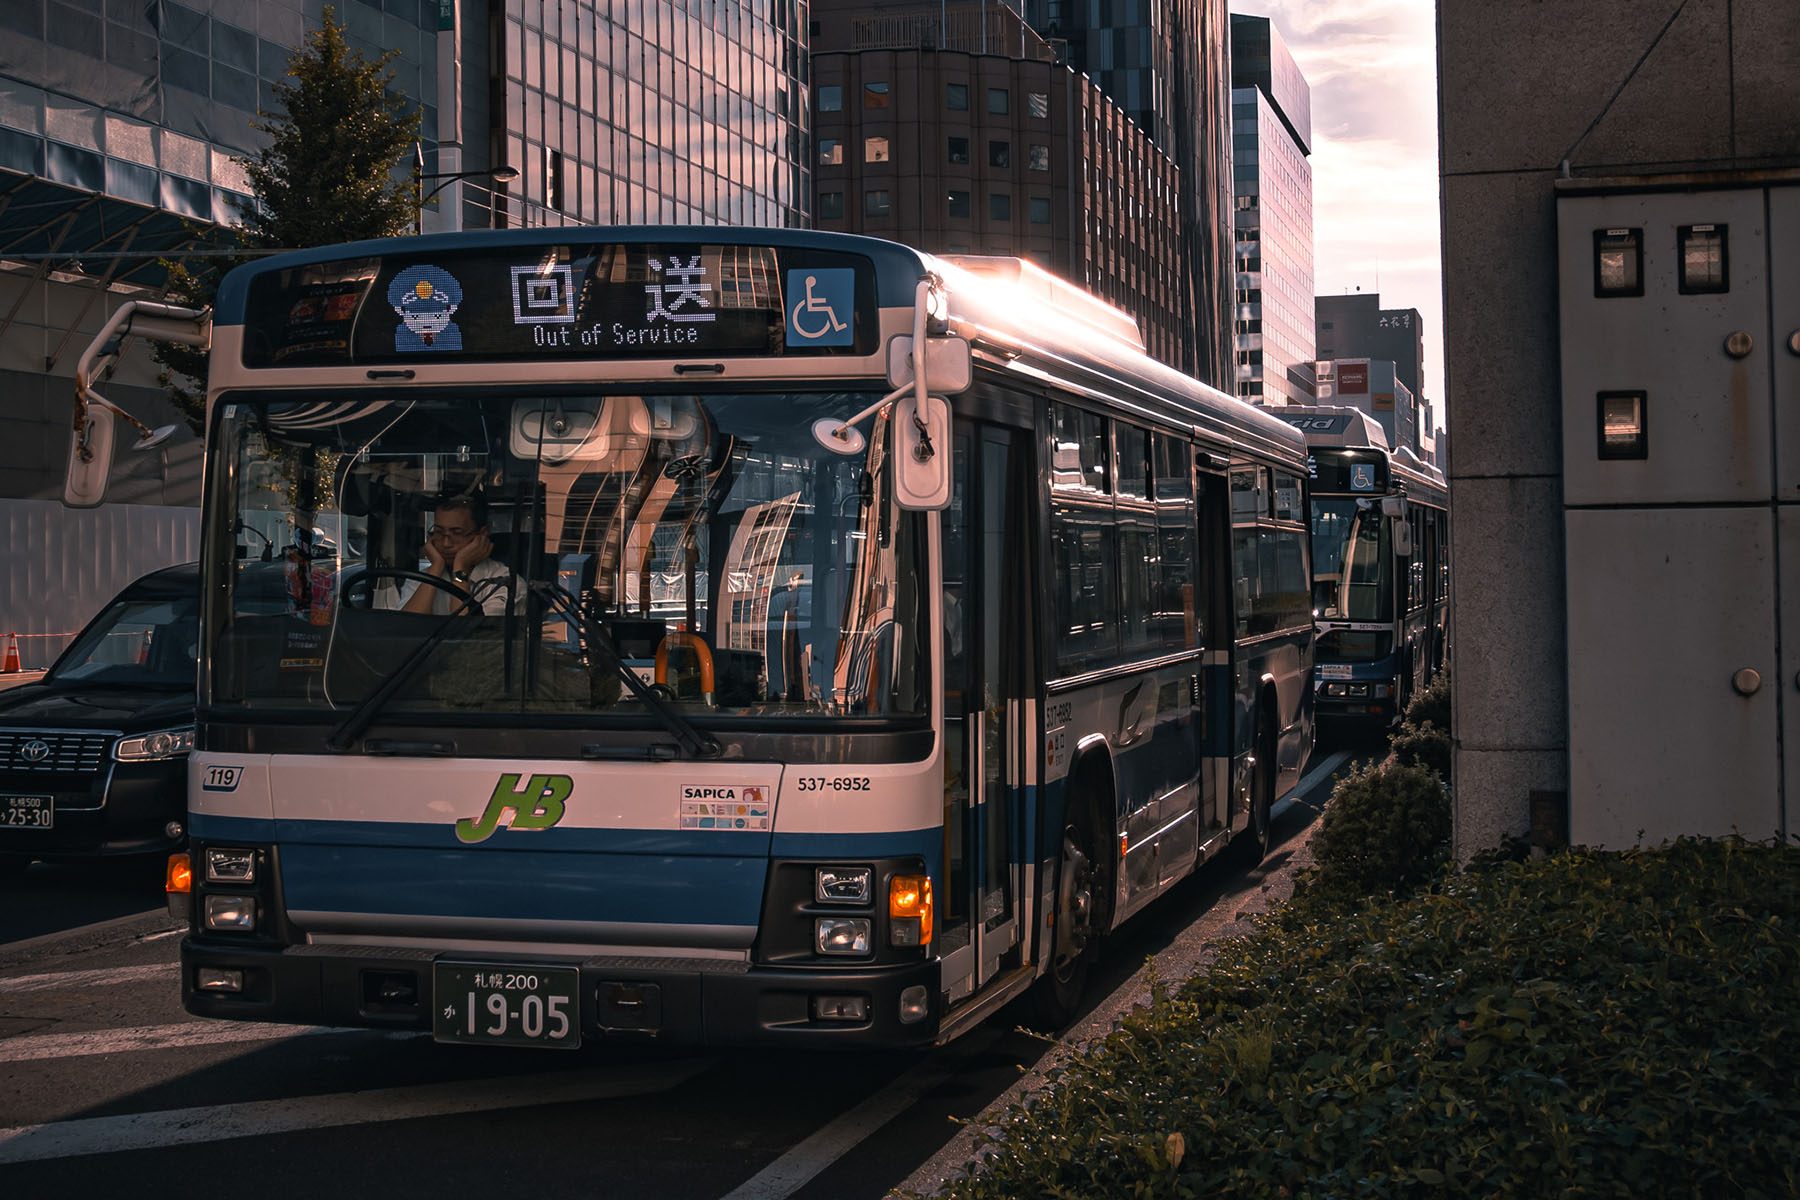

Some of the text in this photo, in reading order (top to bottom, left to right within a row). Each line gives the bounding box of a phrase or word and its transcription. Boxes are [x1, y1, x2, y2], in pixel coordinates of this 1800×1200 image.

[511, 256, 716, 324] 回送
[533, 322, 698, 346] Out of Service
[210, 768, 235, 785] 119
[798, 777, 871, 791] 537-6952
[684, 788, 735, 799] SAPICA
[9, 808, 50, 825] 25-30
[444, 991, 569, 1040] か 19-05
